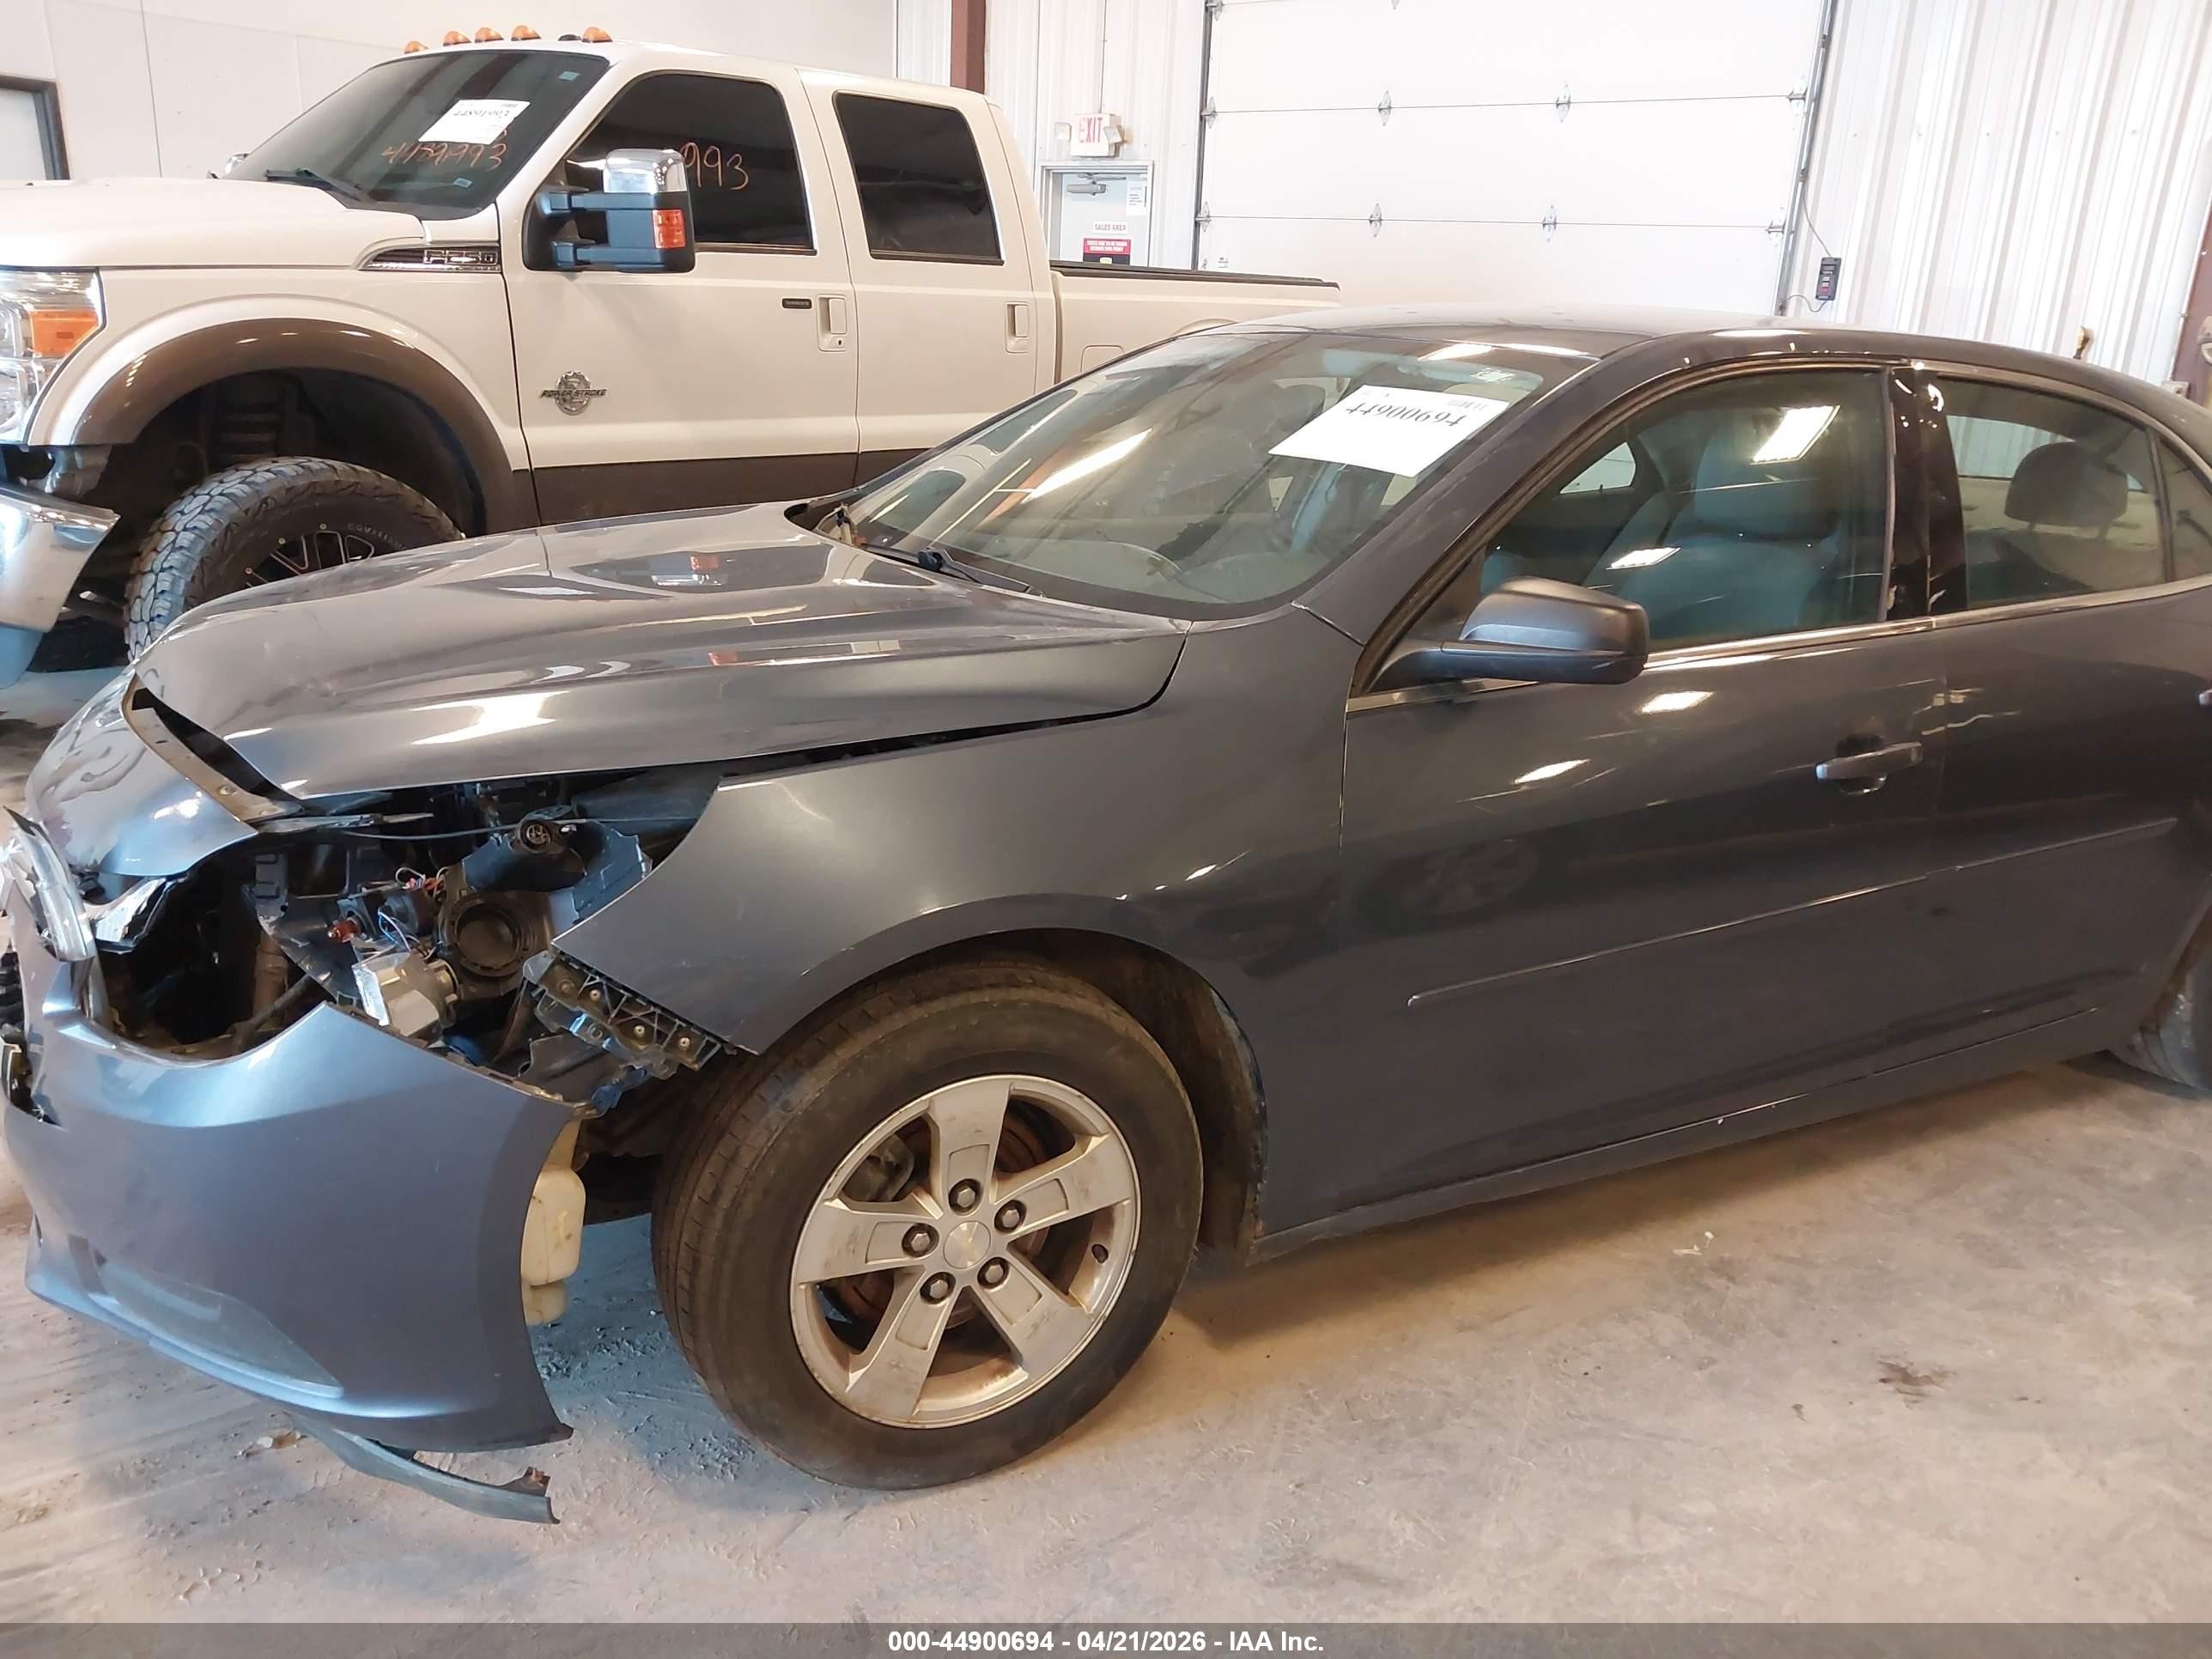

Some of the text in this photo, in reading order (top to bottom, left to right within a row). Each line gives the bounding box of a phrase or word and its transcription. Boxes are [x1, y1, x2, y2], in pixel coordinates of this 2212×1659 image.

[1079, 116, 1103, 143] EXIT
[573, 388, 607, 398] STROKE
[1346, 402, 1468, 427] 44900694
